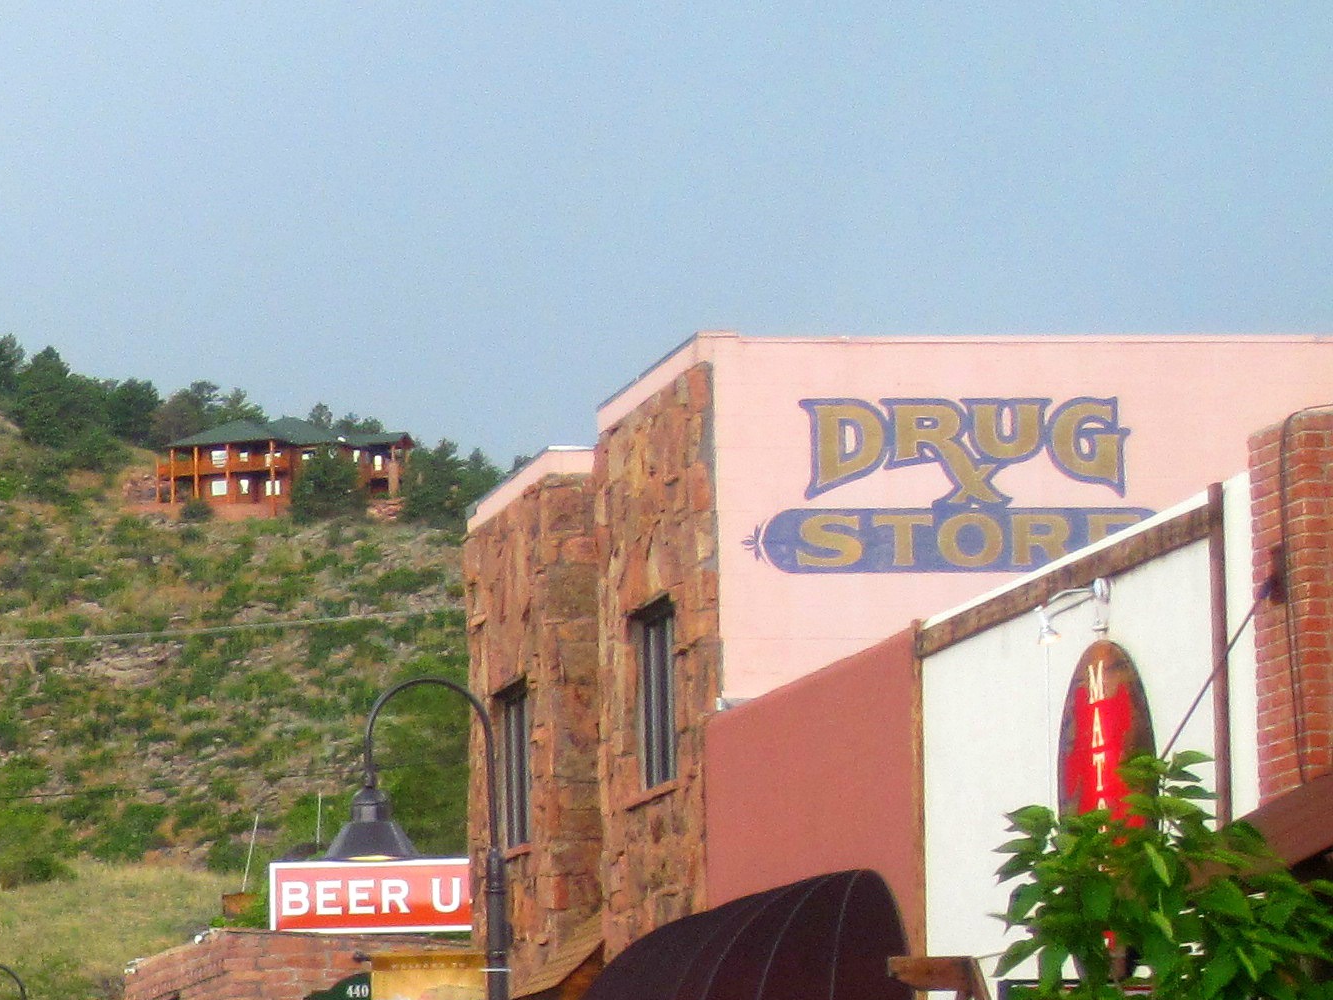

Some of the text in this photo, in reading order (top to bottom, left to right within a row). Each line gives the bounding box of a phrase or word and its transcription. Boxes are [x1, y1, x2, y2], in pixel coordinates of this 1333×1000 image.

[798, 397, 1131, 503] DRUG
[281, 877, 472, 917] BEER U
[346, 984, 369, 998] 440
